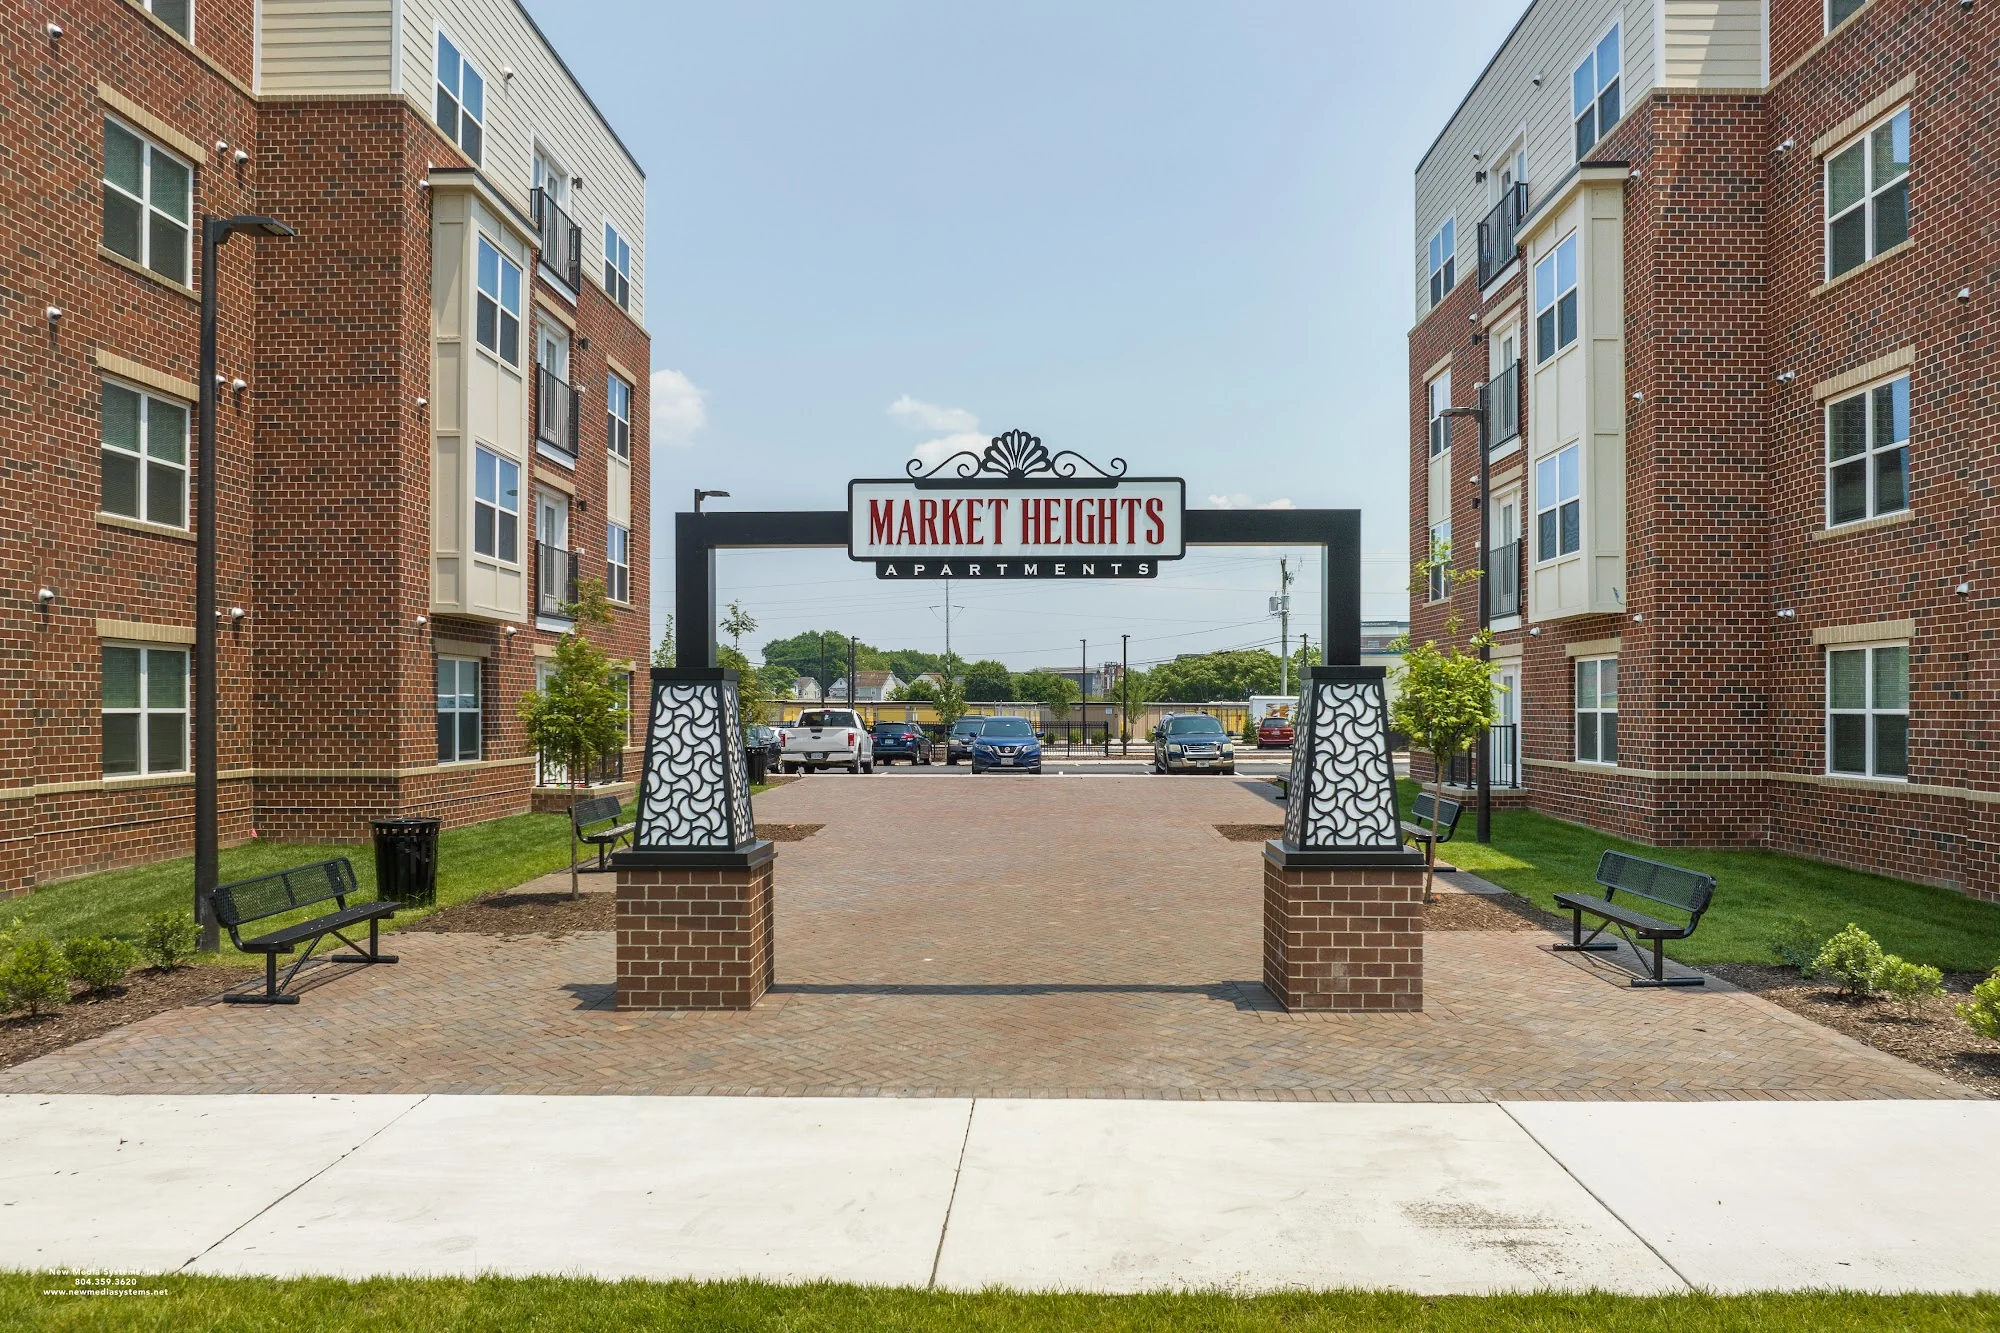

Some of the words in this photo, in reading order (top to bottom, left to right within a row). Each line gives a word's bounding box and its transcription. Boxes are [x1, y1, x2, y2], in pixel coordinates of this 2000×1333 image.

[869, 499, 1008, 545] MARKET
[1021, 498, 1164, 545] HEIGHTS
[885, 563, 1149, 576] APARTMENTS
